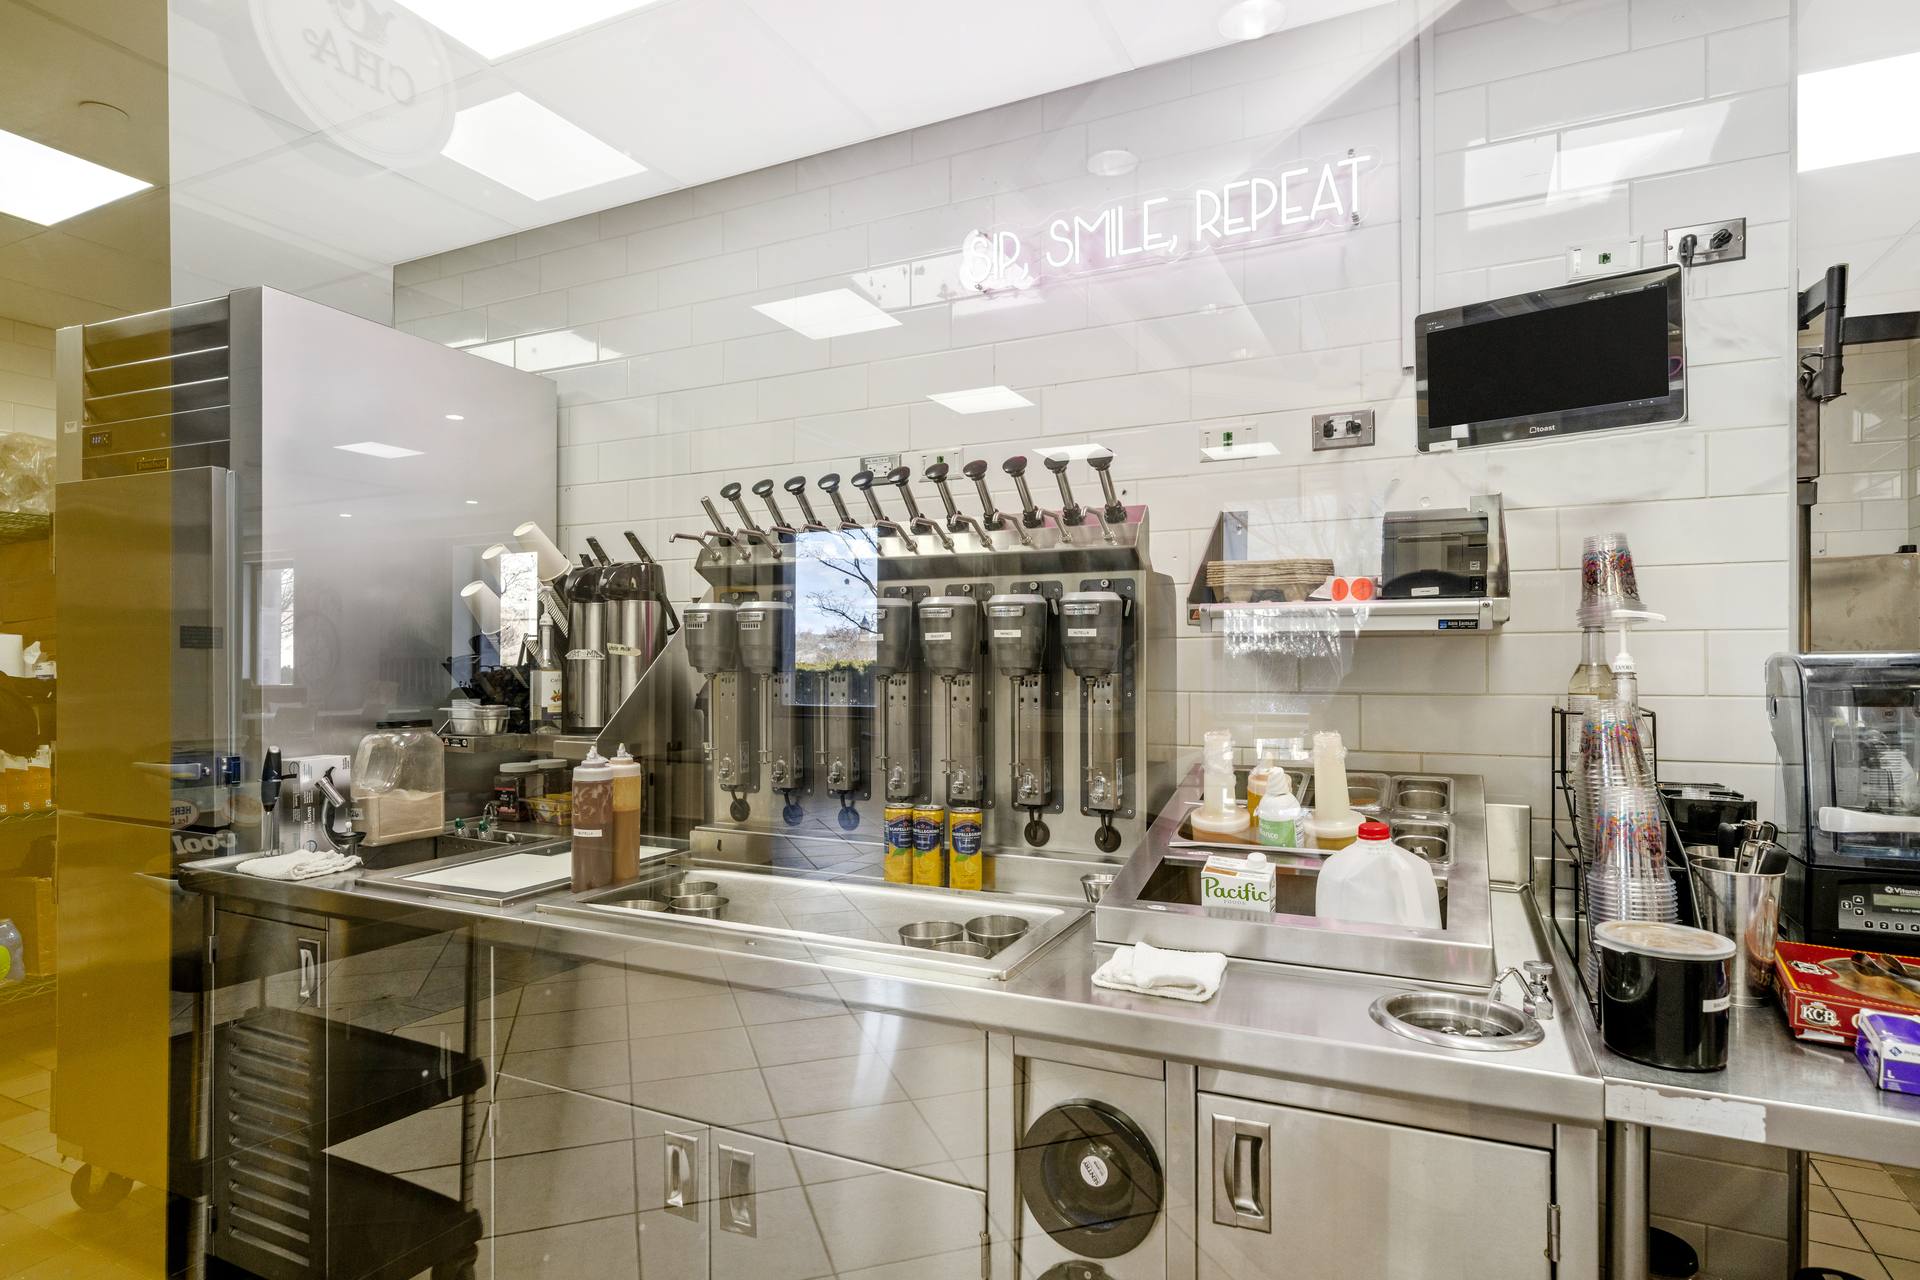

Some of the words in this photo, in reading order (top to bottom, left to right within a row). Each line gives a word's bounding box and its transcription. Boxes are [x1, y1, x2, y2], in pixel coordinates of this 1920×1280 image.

[969, 230, 1029, 280] SIP,
[1046, 197, 1179, 268] SMILE,
[1195, 155, 1372, 242] REPEAT
[1537, 424, 1556, 432] toast
[1201, 876, 1270, 903] Pacific
[1887, 1069, 1896, 1079] L
